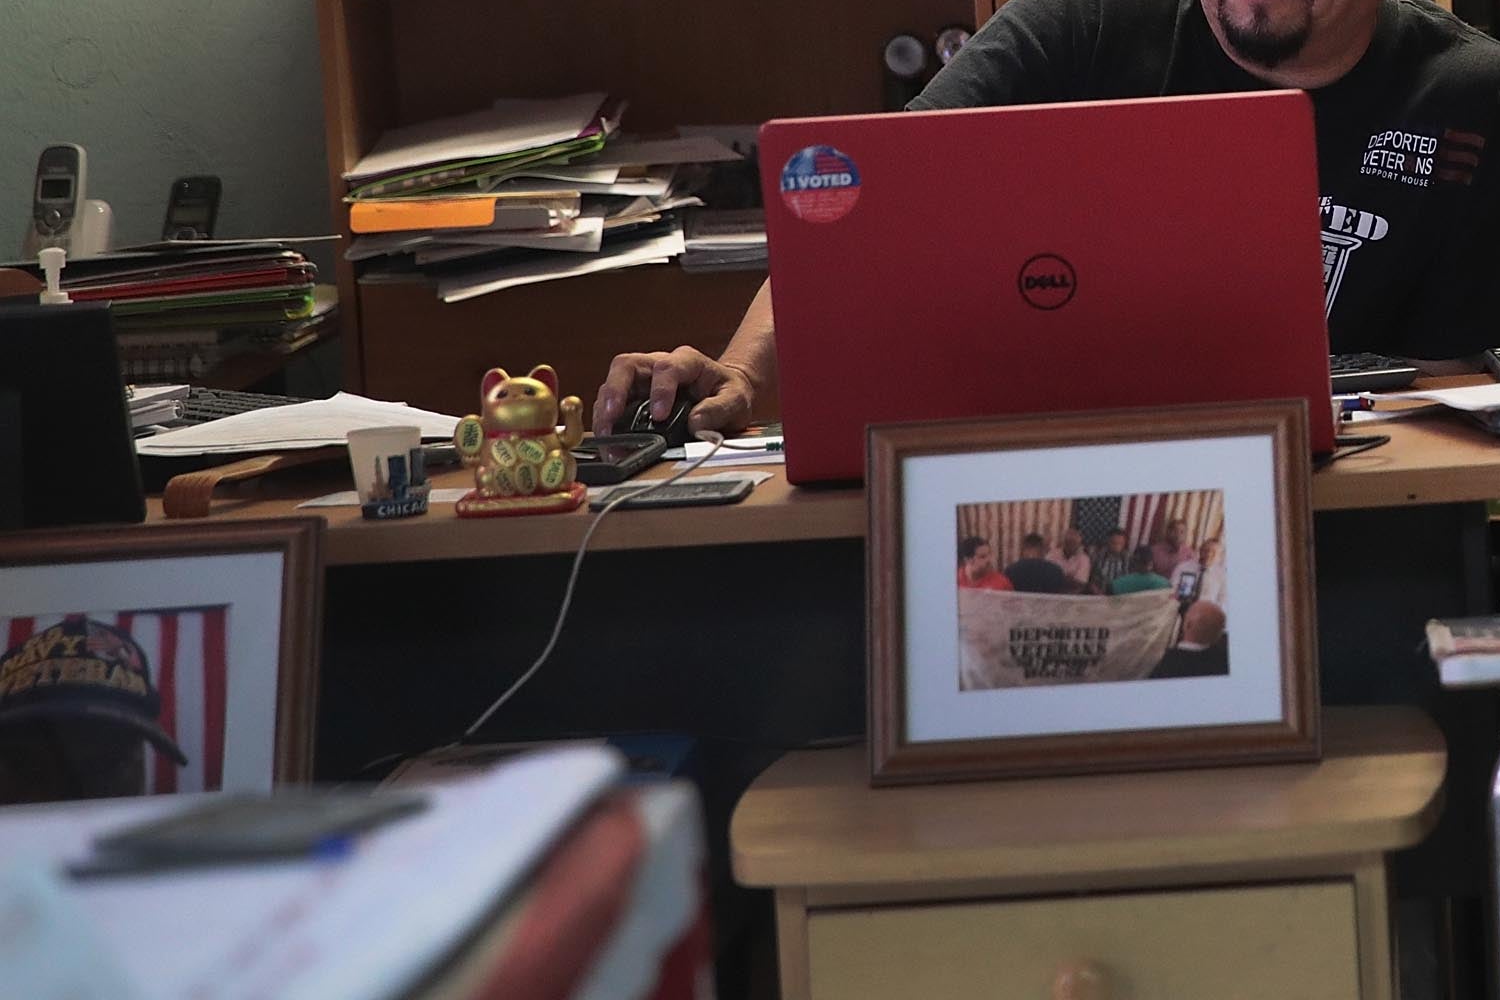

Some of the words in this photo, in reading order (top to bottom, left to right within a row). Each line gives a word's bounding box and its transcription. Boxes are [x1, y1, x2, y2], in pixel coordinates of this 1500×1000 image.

[1367, 130, 1437, 155] DEPORTED
[787, 177, 796, 190] I
[797, 173, 853, 188] VOTED
[1360, 166, 1398, 181] SUPPORT
[1401, 175, 1429, 187] HOUSE
[1024, 273, 1071, 290] DELL
[1009, 626, 1110, 642] DEPORTED
